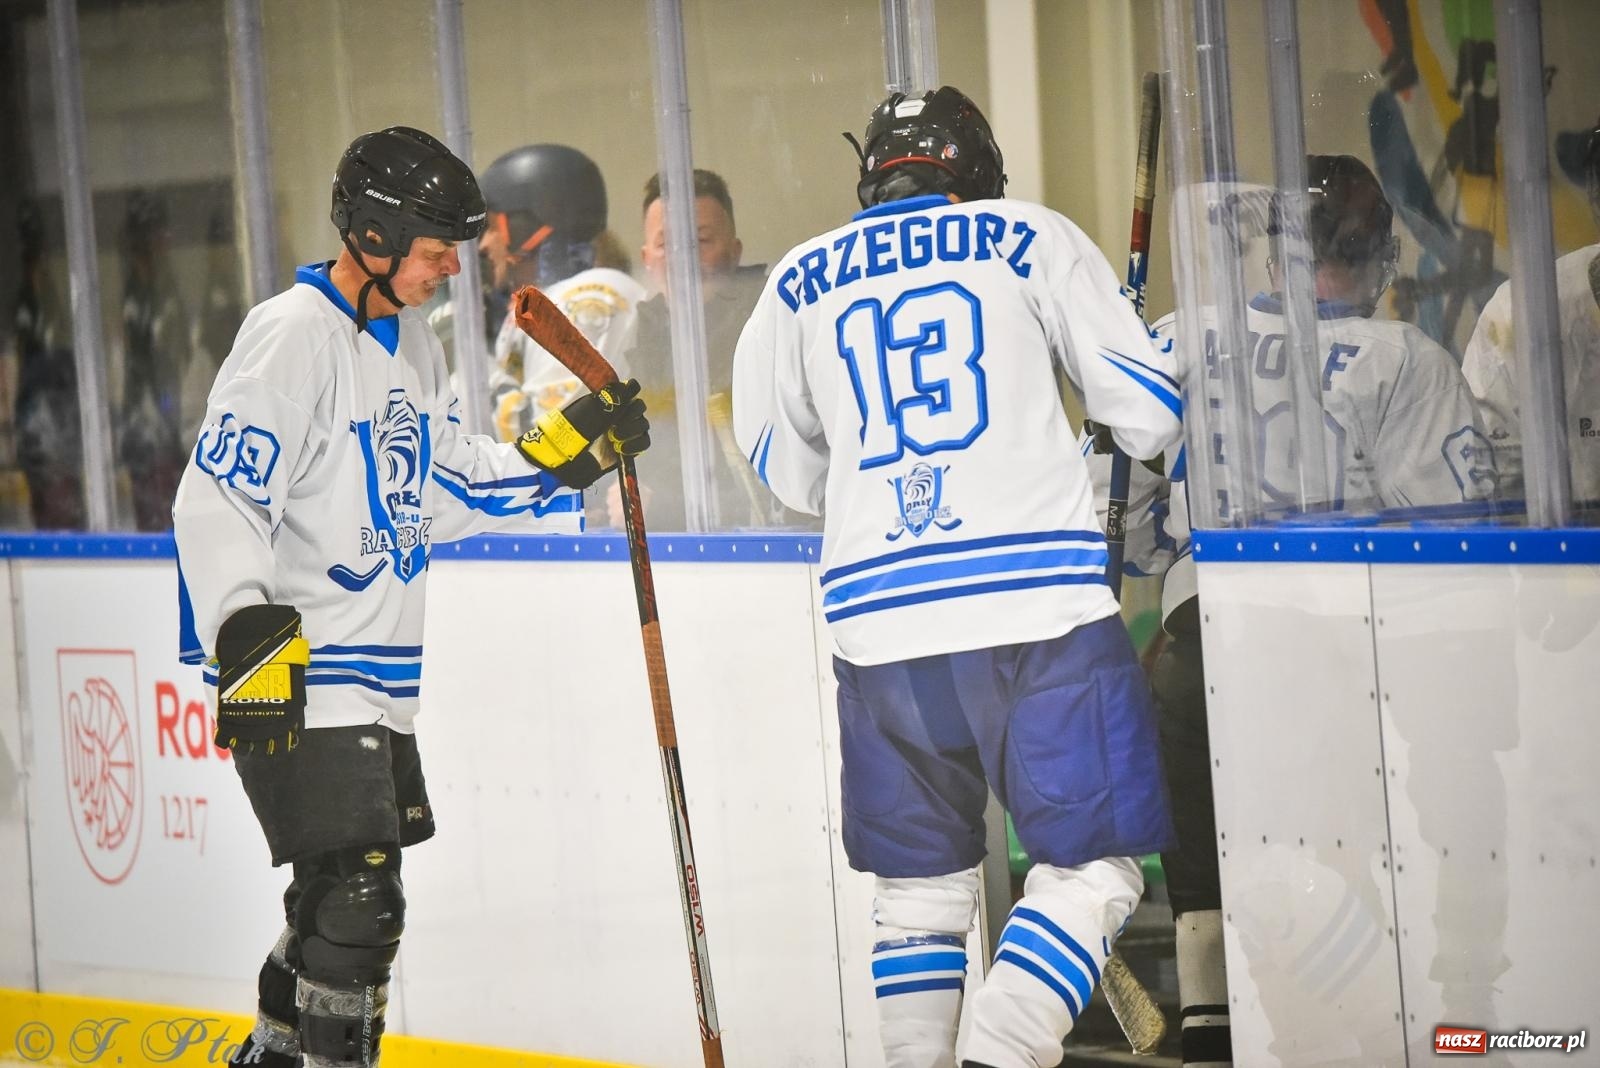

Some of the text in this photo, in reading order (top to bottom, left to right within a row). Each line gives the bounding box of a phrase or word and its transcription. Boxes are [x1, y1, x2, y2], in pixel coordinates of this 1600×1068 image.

[365, 189, 402, 206] BAUER
[776, 212, 1037, 314] GRZEGORZ
[835, 280, 989, 471] 13
[160, 795, 208, 857] 1217
